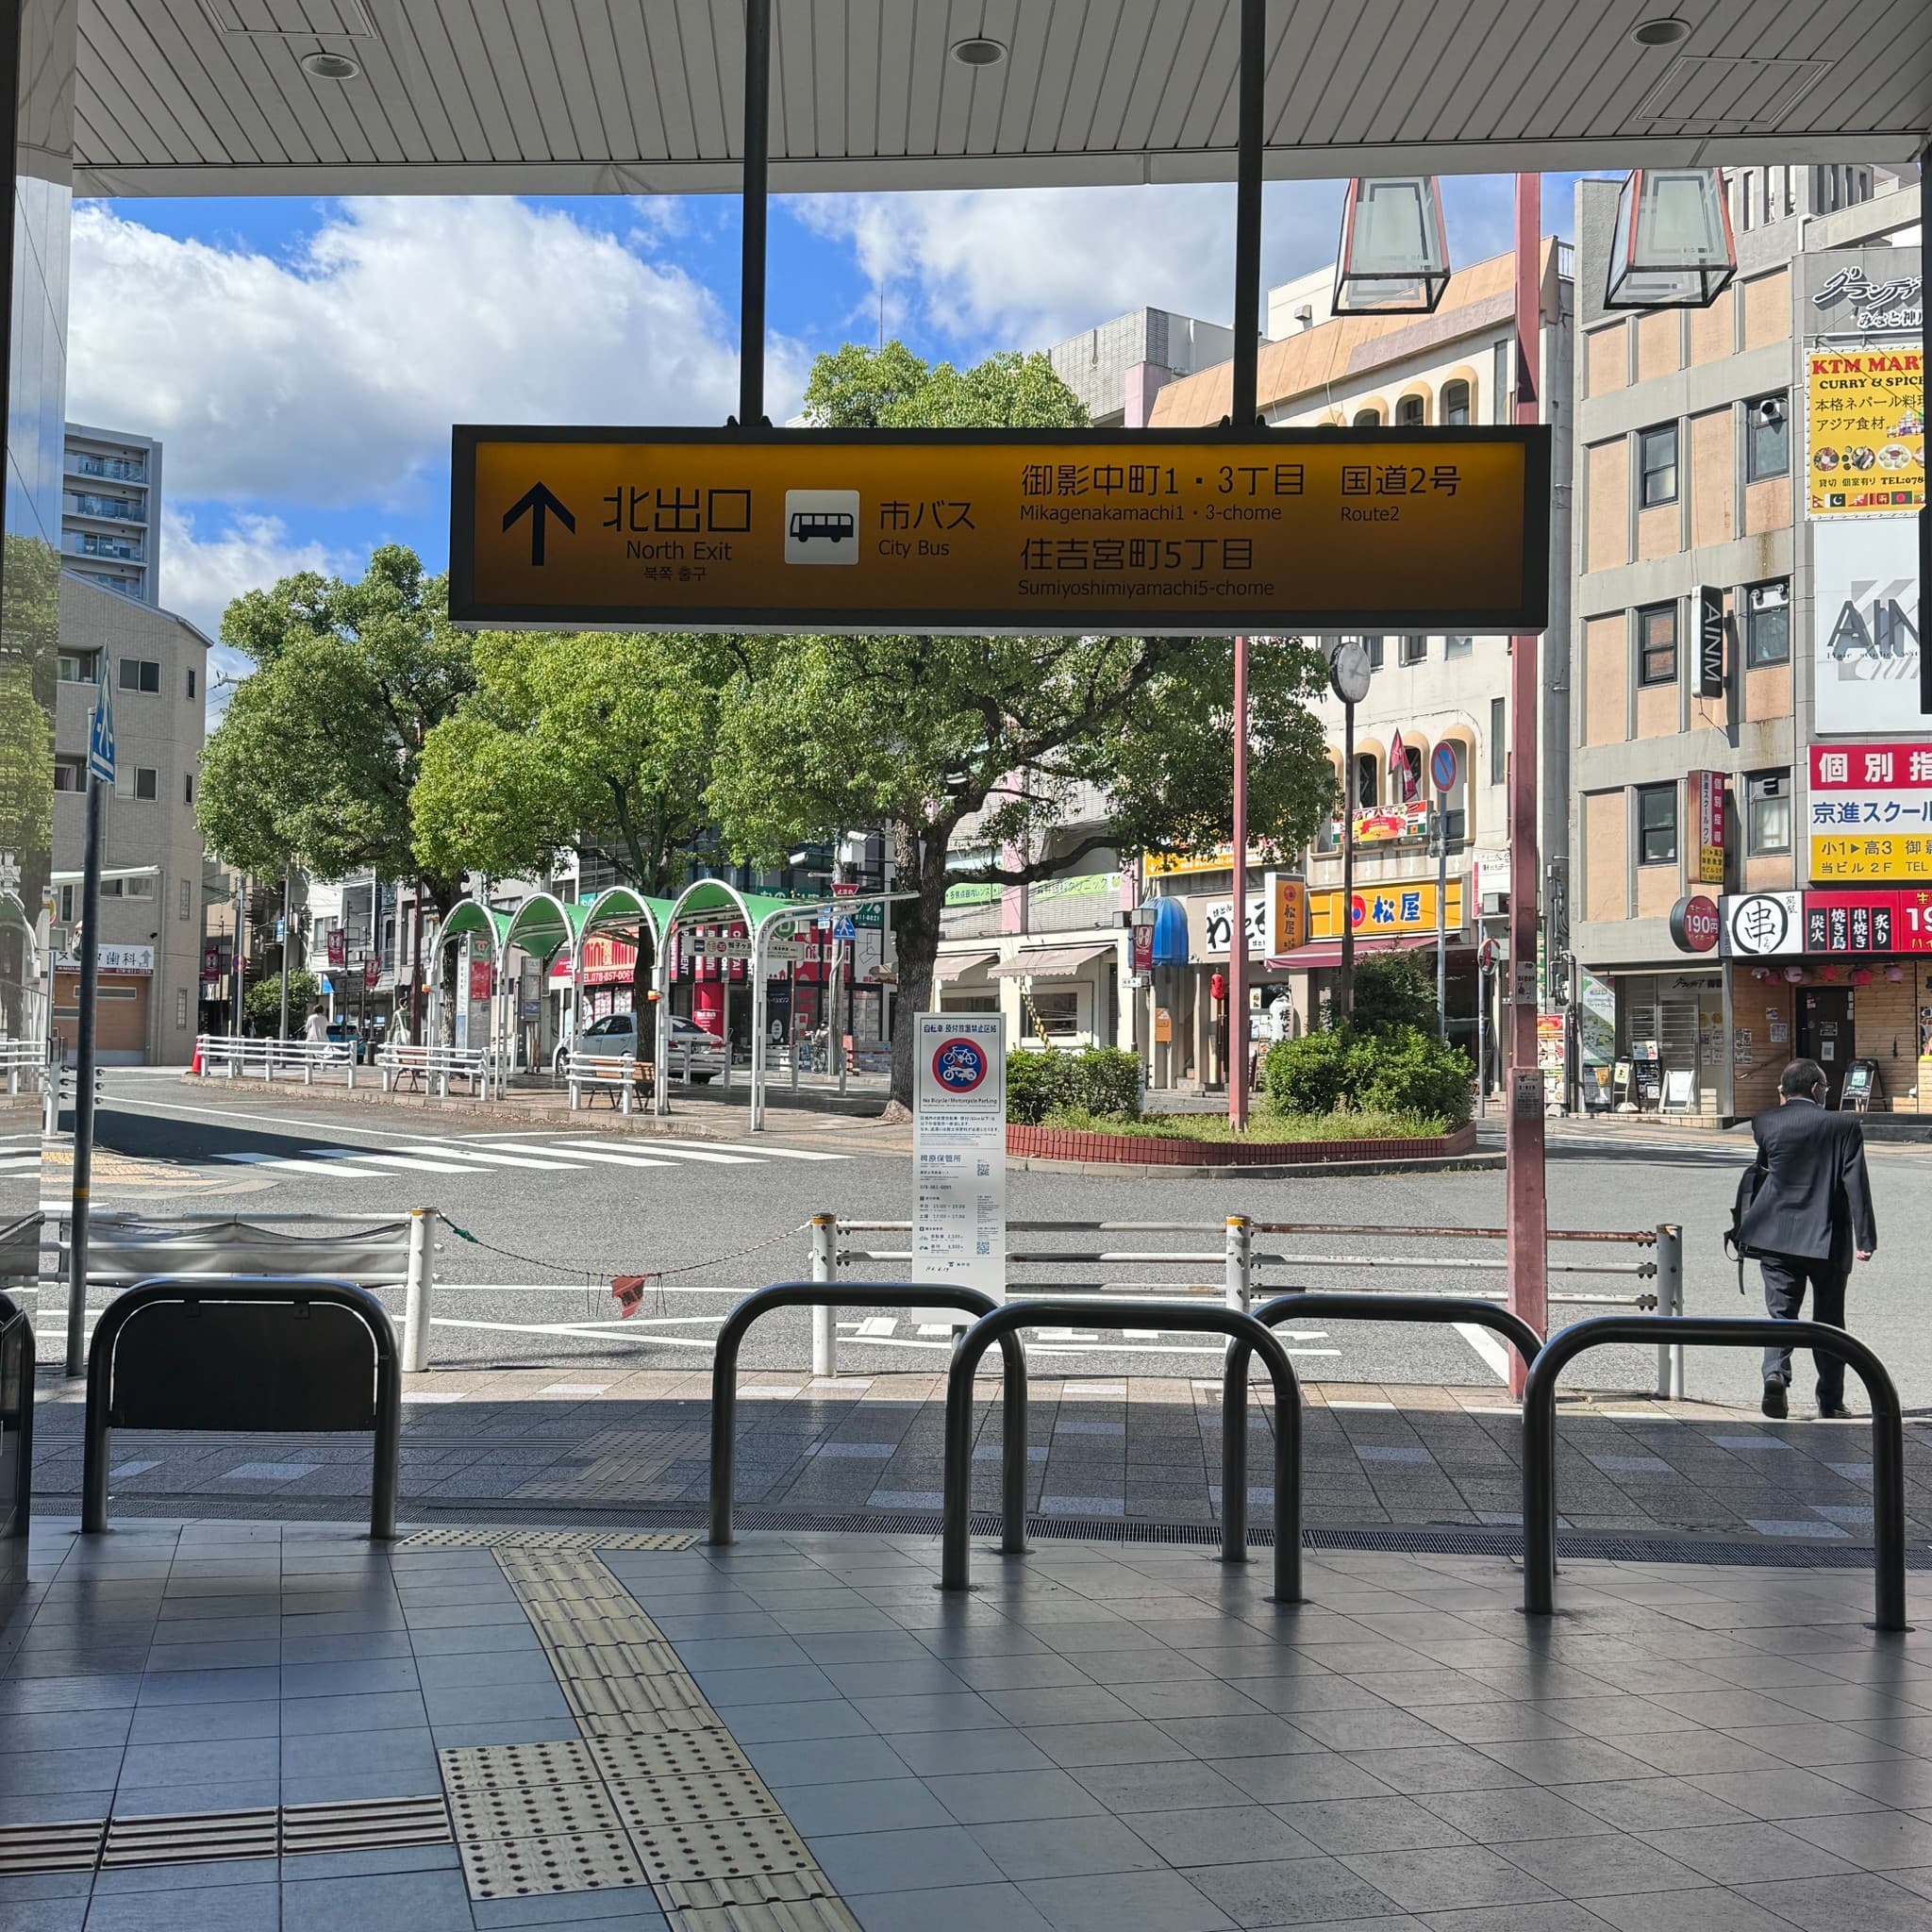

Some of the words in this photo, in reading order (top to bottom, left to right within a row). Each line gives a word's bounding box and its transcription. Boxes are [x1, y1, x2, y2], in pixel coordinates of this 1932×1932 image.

[1812, 358, 1861, 375] KTM
[1868, 355, 1924, 373] MAR
[1820, 378, 1868, 390] CURRY
[1871, 377, 1883, 389] &
[1816, 416, 1885, 432] アジア食材
[1341, 464, 1462, 497] 国道2号
[603, 486, 751, 533] 北出口
[879, 500, 975, 530] 市バス
[1341, 506, 1399, 522] Route2
[626, 540, 685, 560] North
[693, 541, 732, 560] Exit
[878, 539, 911, 559] City
[918, 540, 950, 557] Bus
[1020, 538, 1254, 570] 住吉宮町5丁目
[1018, 579, 1274, 598] Sumiyoshimiyamachi5-chome
[1705, 601, 1722, 682] AINM
[1819, 752, 1932, 783] 個別指
[1822, 861, 1864, 874] 当ビル
[1905, 861, 1929, 873] TEL
[1284, 904, 1296, 935] 松屋
[1373, 892, 1420, 924] 松屋
[1686, 915, 1718, 934] 190円
[1811, 914, 1825, 942] 炭火
[1831, 908, 1846, 950] 焼き鳥
[1853, 908, 1868, 948] 串焼き
[1874, 914, 1890, 944] 炙り
